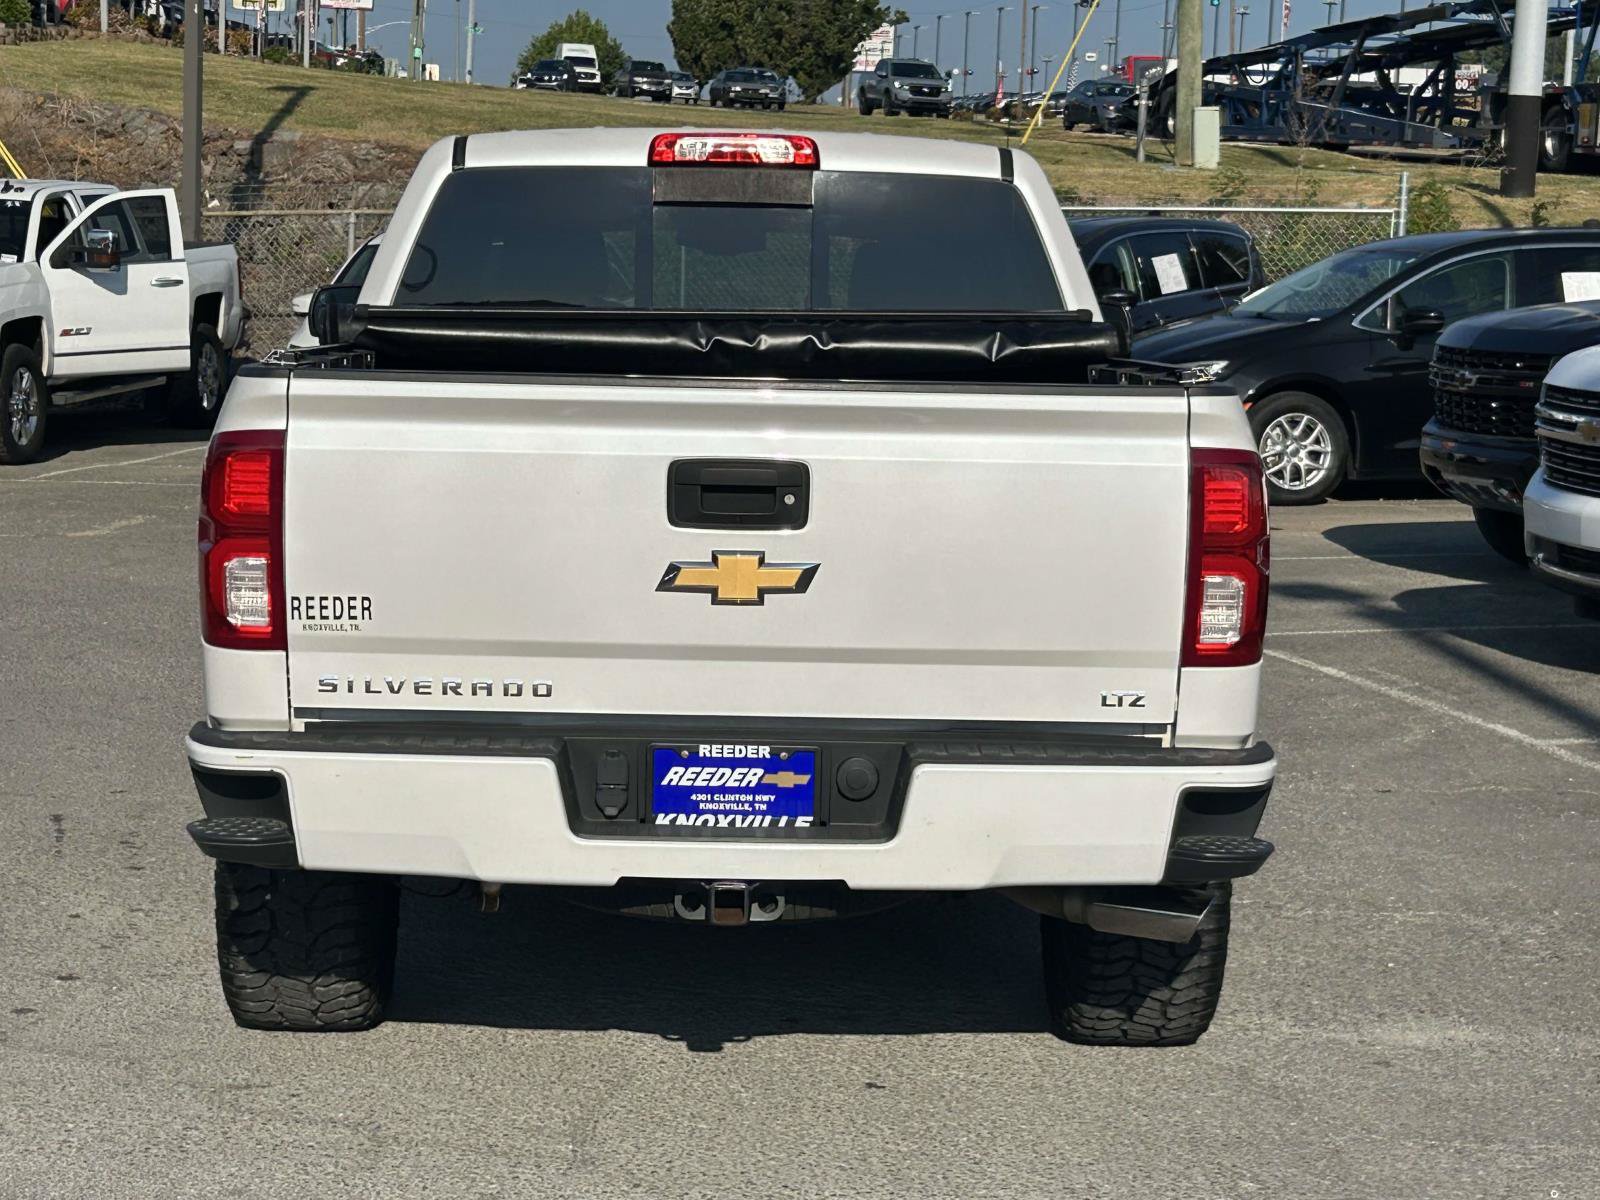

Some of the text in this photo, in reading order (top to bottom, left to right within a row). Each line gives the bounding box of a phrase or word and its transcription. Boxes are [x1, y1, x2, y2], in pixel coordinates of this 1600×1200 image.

[291, 596, 372, 620] REEDER
[302, 623, 348, 632] KNOXVILLE,
[318, 675, 553, 698] SILVERADO
[1100, 690, 1146, 707] LTZ
[699, 744, 771, 759] REEDER
[660, 766, 765, 788] REEDER
[690, 793, 711, 801] 4301
[699, 803, 752, 811] KNOXVILLE,
